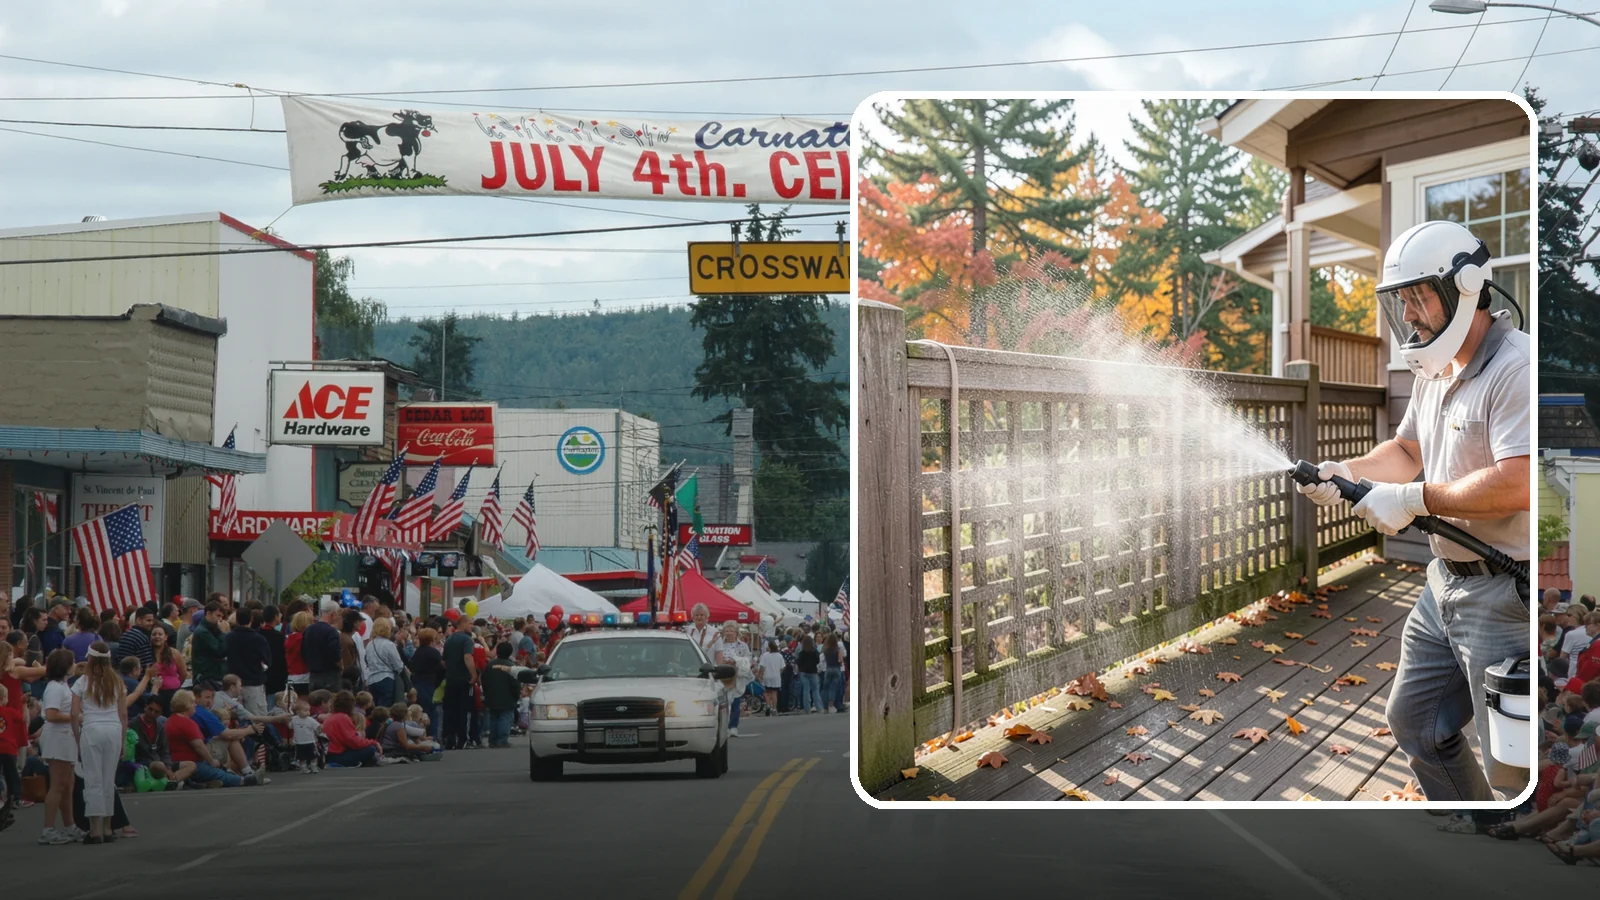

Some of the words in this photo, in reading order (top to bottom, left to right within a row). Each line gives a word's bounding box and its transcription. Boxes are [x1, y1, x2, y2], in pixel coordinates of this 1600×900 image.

[481, 141, 605, 192] JULY
[632, 150, 746, 197] 4th.
[697, 255, 850, 279] CROSSWA
[283, 380, 374, 420] ACE
[406, 409, 452, 422] CEDAR
[283, 421, 371, 436] Hardware
[416, 428, 477, 447] Coca-Cola
[83, 485, 93, 494] St.
[96, 485, 124, 495] Vincent
[126, 486, 136, 495] de
[138, 486, 155, 495] Paul
[81, 503, 154, 522] THRT
[688, 526, 742, 535] CRNATION
[699, 535, 730, 543] GLASS
